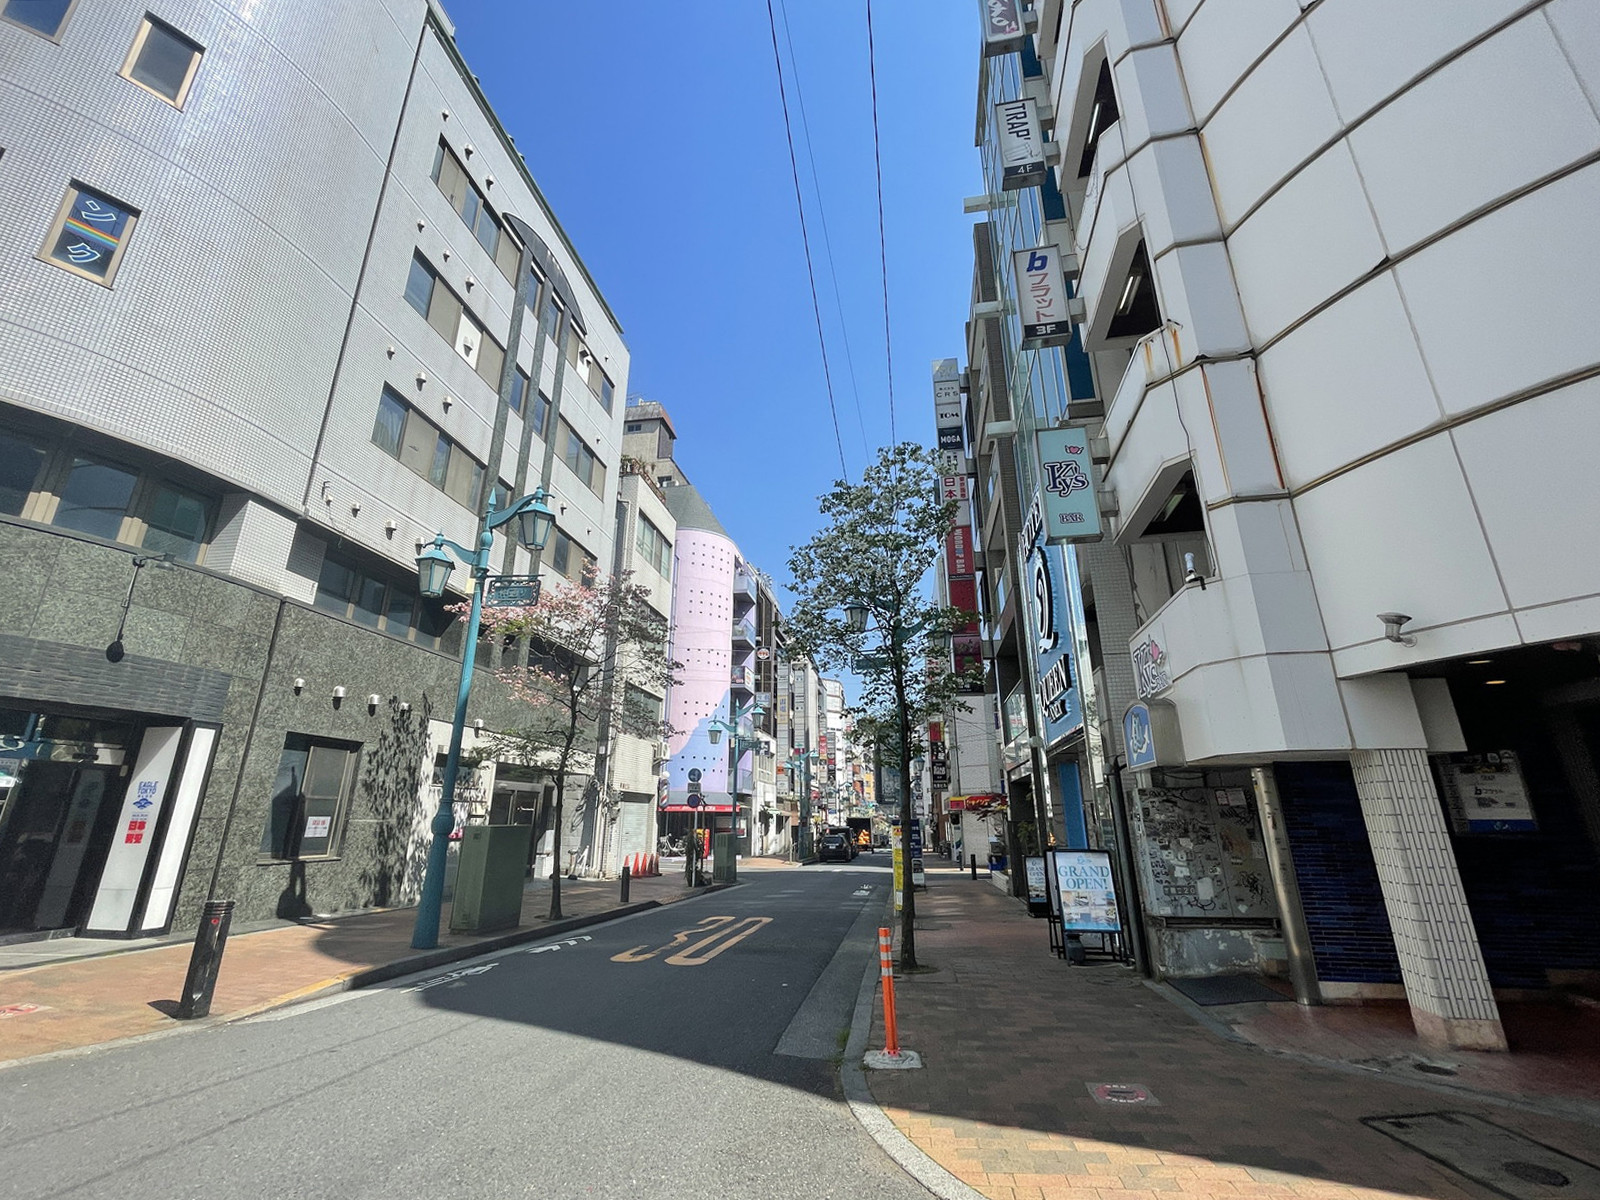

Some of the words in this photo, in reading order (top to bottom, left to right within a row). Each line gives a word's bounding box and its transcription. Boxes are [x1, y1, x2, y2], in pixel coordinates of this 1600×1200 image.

[1018, 164, 1033, 174] 4F
[1035, 324, 1057, 335] 3F
[940, 434, 962, 444] MOGA
[1059, 512, 1085, 524] BAR
[1039, 654, 1070, 718] QUEEN
[1058, 865, 1110, 878] GRAND
[1066, 877, 1109, 890] OPEN!
[610, 916, 773, 966] 30
